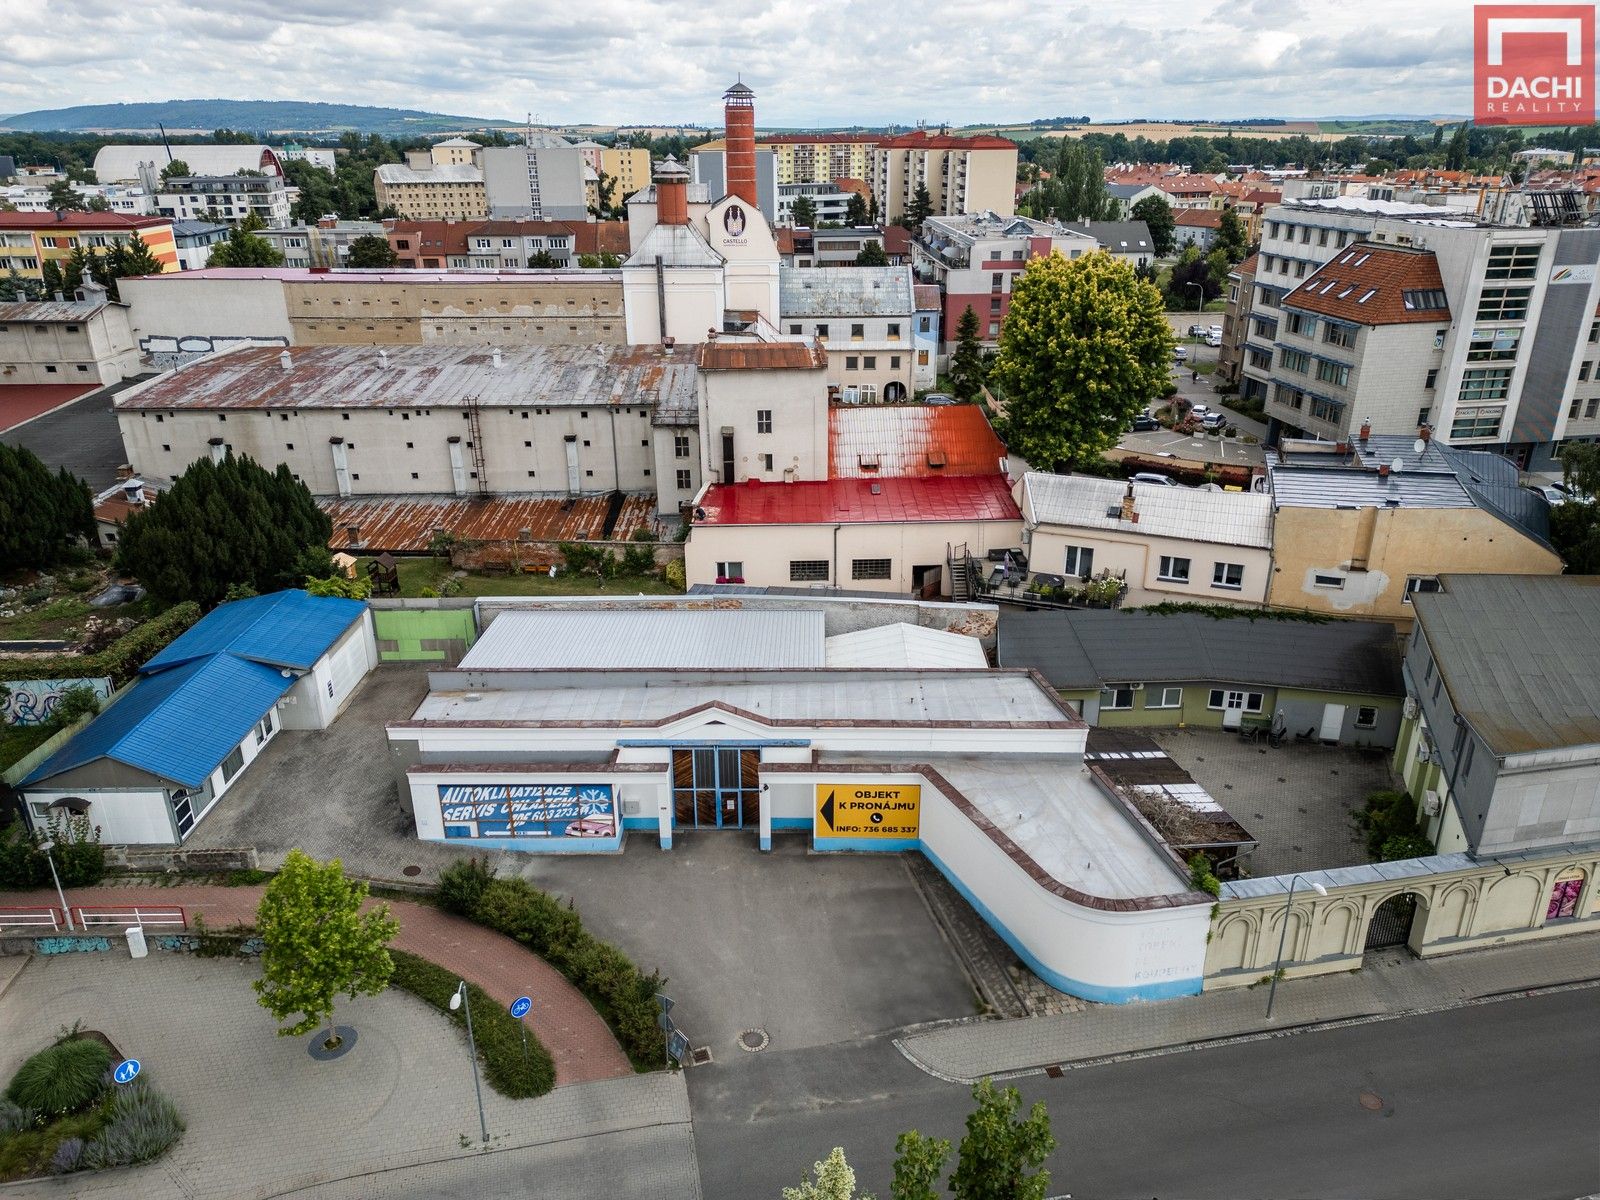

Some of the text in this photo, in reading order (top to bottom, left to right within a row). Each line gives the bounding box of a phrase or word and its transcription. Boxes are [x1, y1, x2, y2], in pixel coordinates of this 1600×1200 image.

[442, 786, 572, 804] AUTOKLIMATIZACE
[854, 790, 900, 799] OBJEKT
[839, 800, 916, 810] K PRONÁJMU
[443, 804, 497, 822] SERVIS
